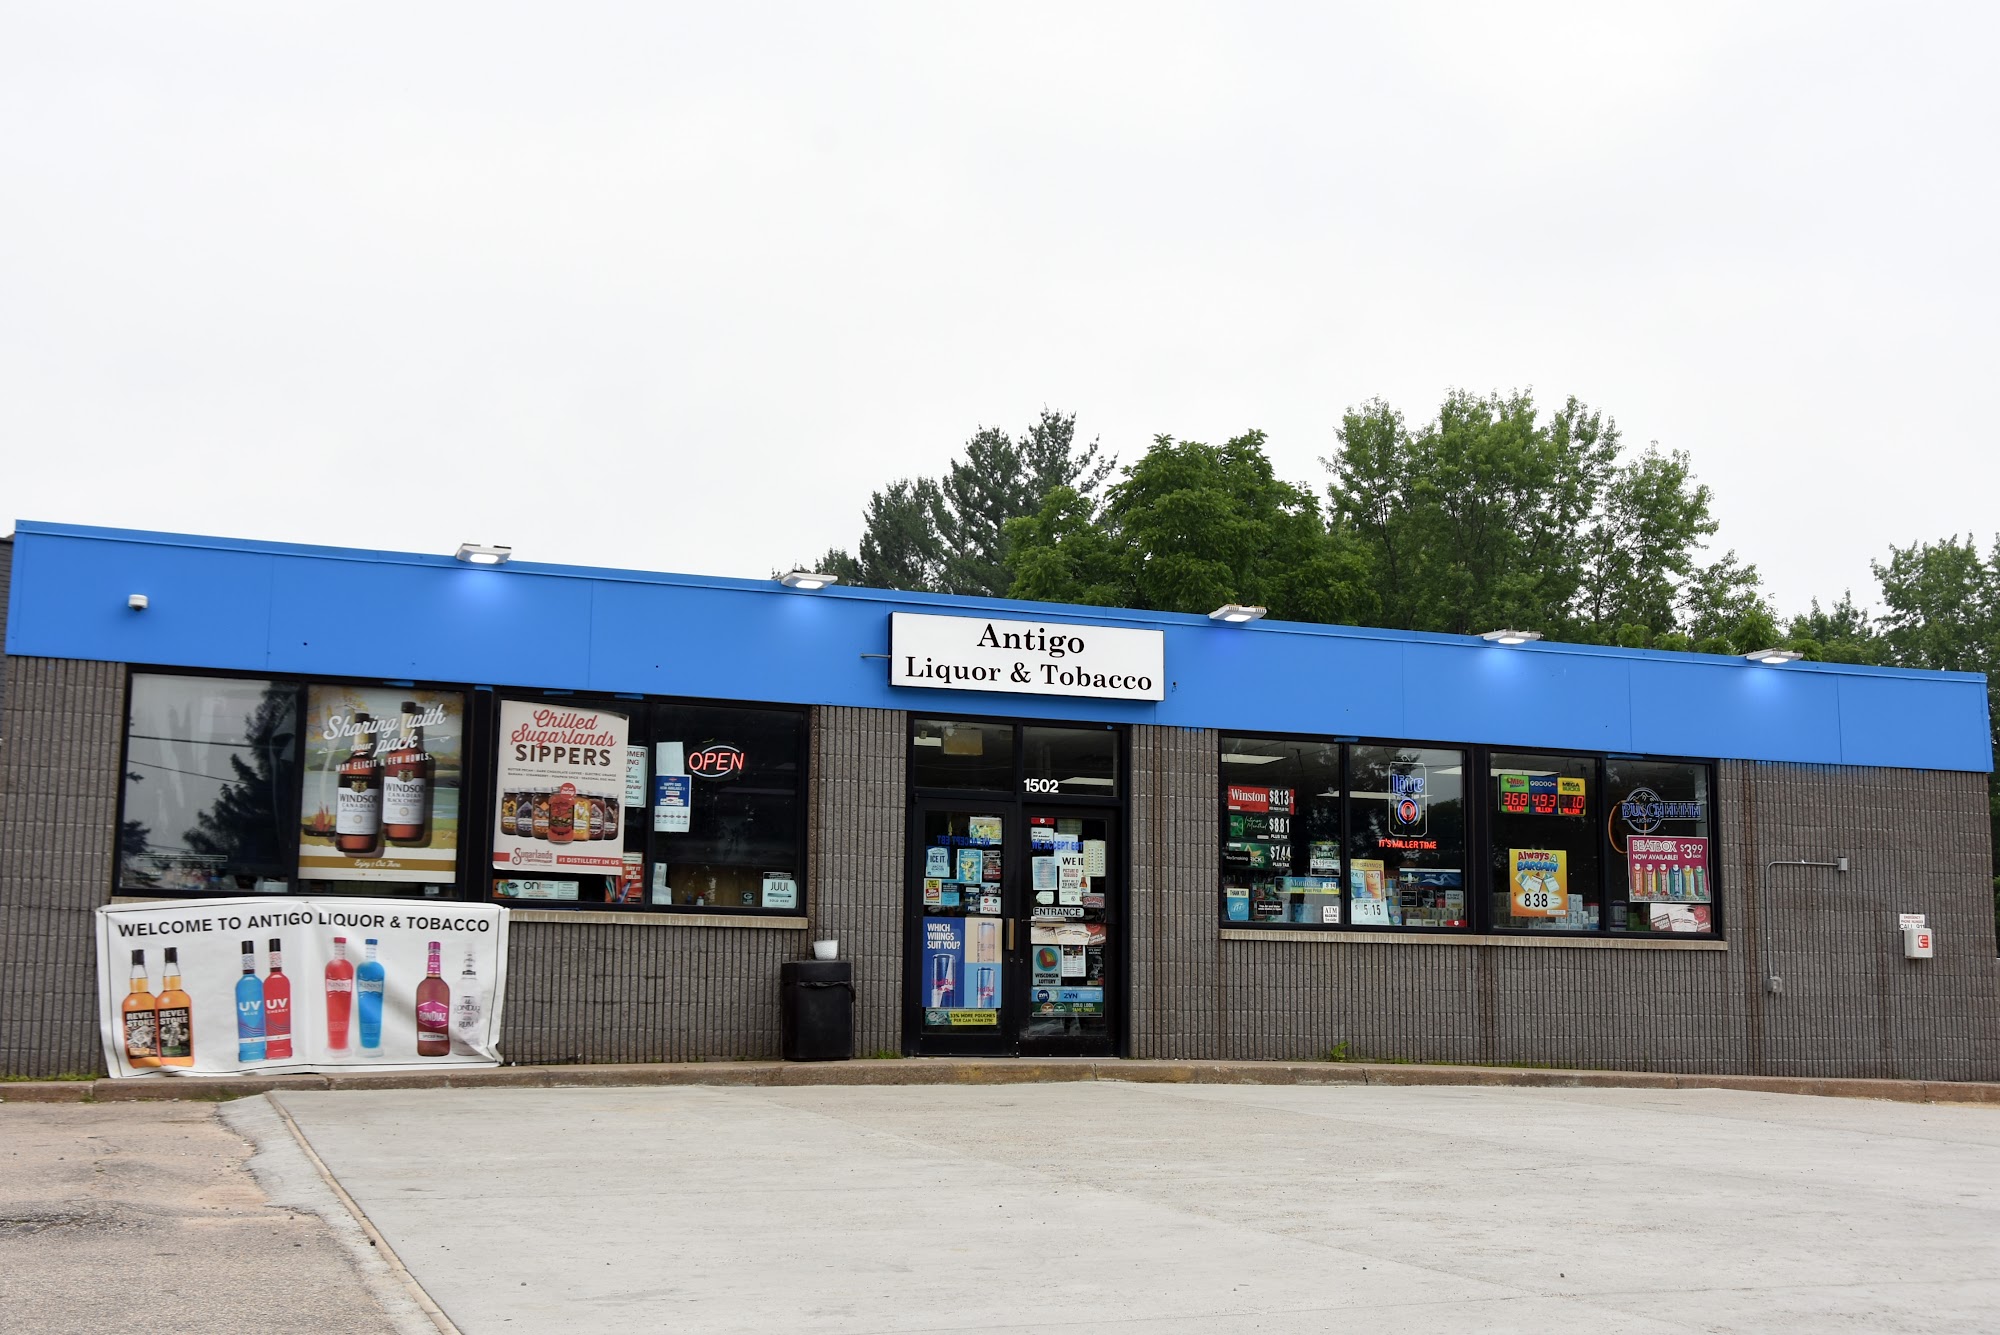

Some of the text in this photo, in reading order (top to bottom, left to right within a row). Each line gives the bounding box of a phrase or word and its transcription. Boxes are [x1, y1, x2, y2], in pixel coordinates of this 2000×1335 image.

[977, 623, 1086, 658] Antigo
[905, 656, 1153, 691] Liquor & Tobacco
[323, 704, 447, 741] Sharing with
[533, 709, 599, 732] Chilled
[510, 723, 617, 749] Sugarlands
[351, 729, 419, 758] your pack
[514, 744, 611, 767] SIPPERS
[688, 752, 745, 772] OPEN
[335, 763, 351, 773] MAY
[353, 759, 377, 771] ELICIT
[379, 758, 386, 767] A
[388, 756, 404, 767] FEW
[1024, 778, 1060, 793] 1502
[1391, 774, 1424, 793] Lite
[1231, 788, 1267, 803] Winston
[1503, 792, 1529, 806] 368
[1531, 794, 1557, 808] 493
[1031, 841, 1084, 851] WE ACCEPT EBT
[1379, 839, 1437, 850] IT'S MILLER TIME
[1632, 840, 1678, 853] BEATBOX
[512, 847, 553, 866] Sugarlands
[566, 857, 602, 865] DISTILLERY
[1062, 857, 1077, 866] WE
[1518, 851, 1557, 863] Always A
[1517, 862, 1559, 873] BARGAIN
[770, 881, 790, 891] JUUL
[1034, 908, 1081, 917] ENTRANCE
[1363, 904, 1381, 916] 5.15
[118, 911, 490, 937] WELCOME TO ANTIGO LIQUOR & TOBACCO
[927, 923, 951, 932] WHICH
[927, 932, 955, 941] WIIINGS
[927, 941, 961, 950] SUIT YOU?
[239, 1000, 262, 1012] UV
[266, 997, 289, 1010] UV
[126, 1011, 155, 1020] REVEL
[159, 1009, 188, 1018] REVEL
[126, 1018, 155, 1028] STOKE
[159, 1016, 188, 1026] STOKE
